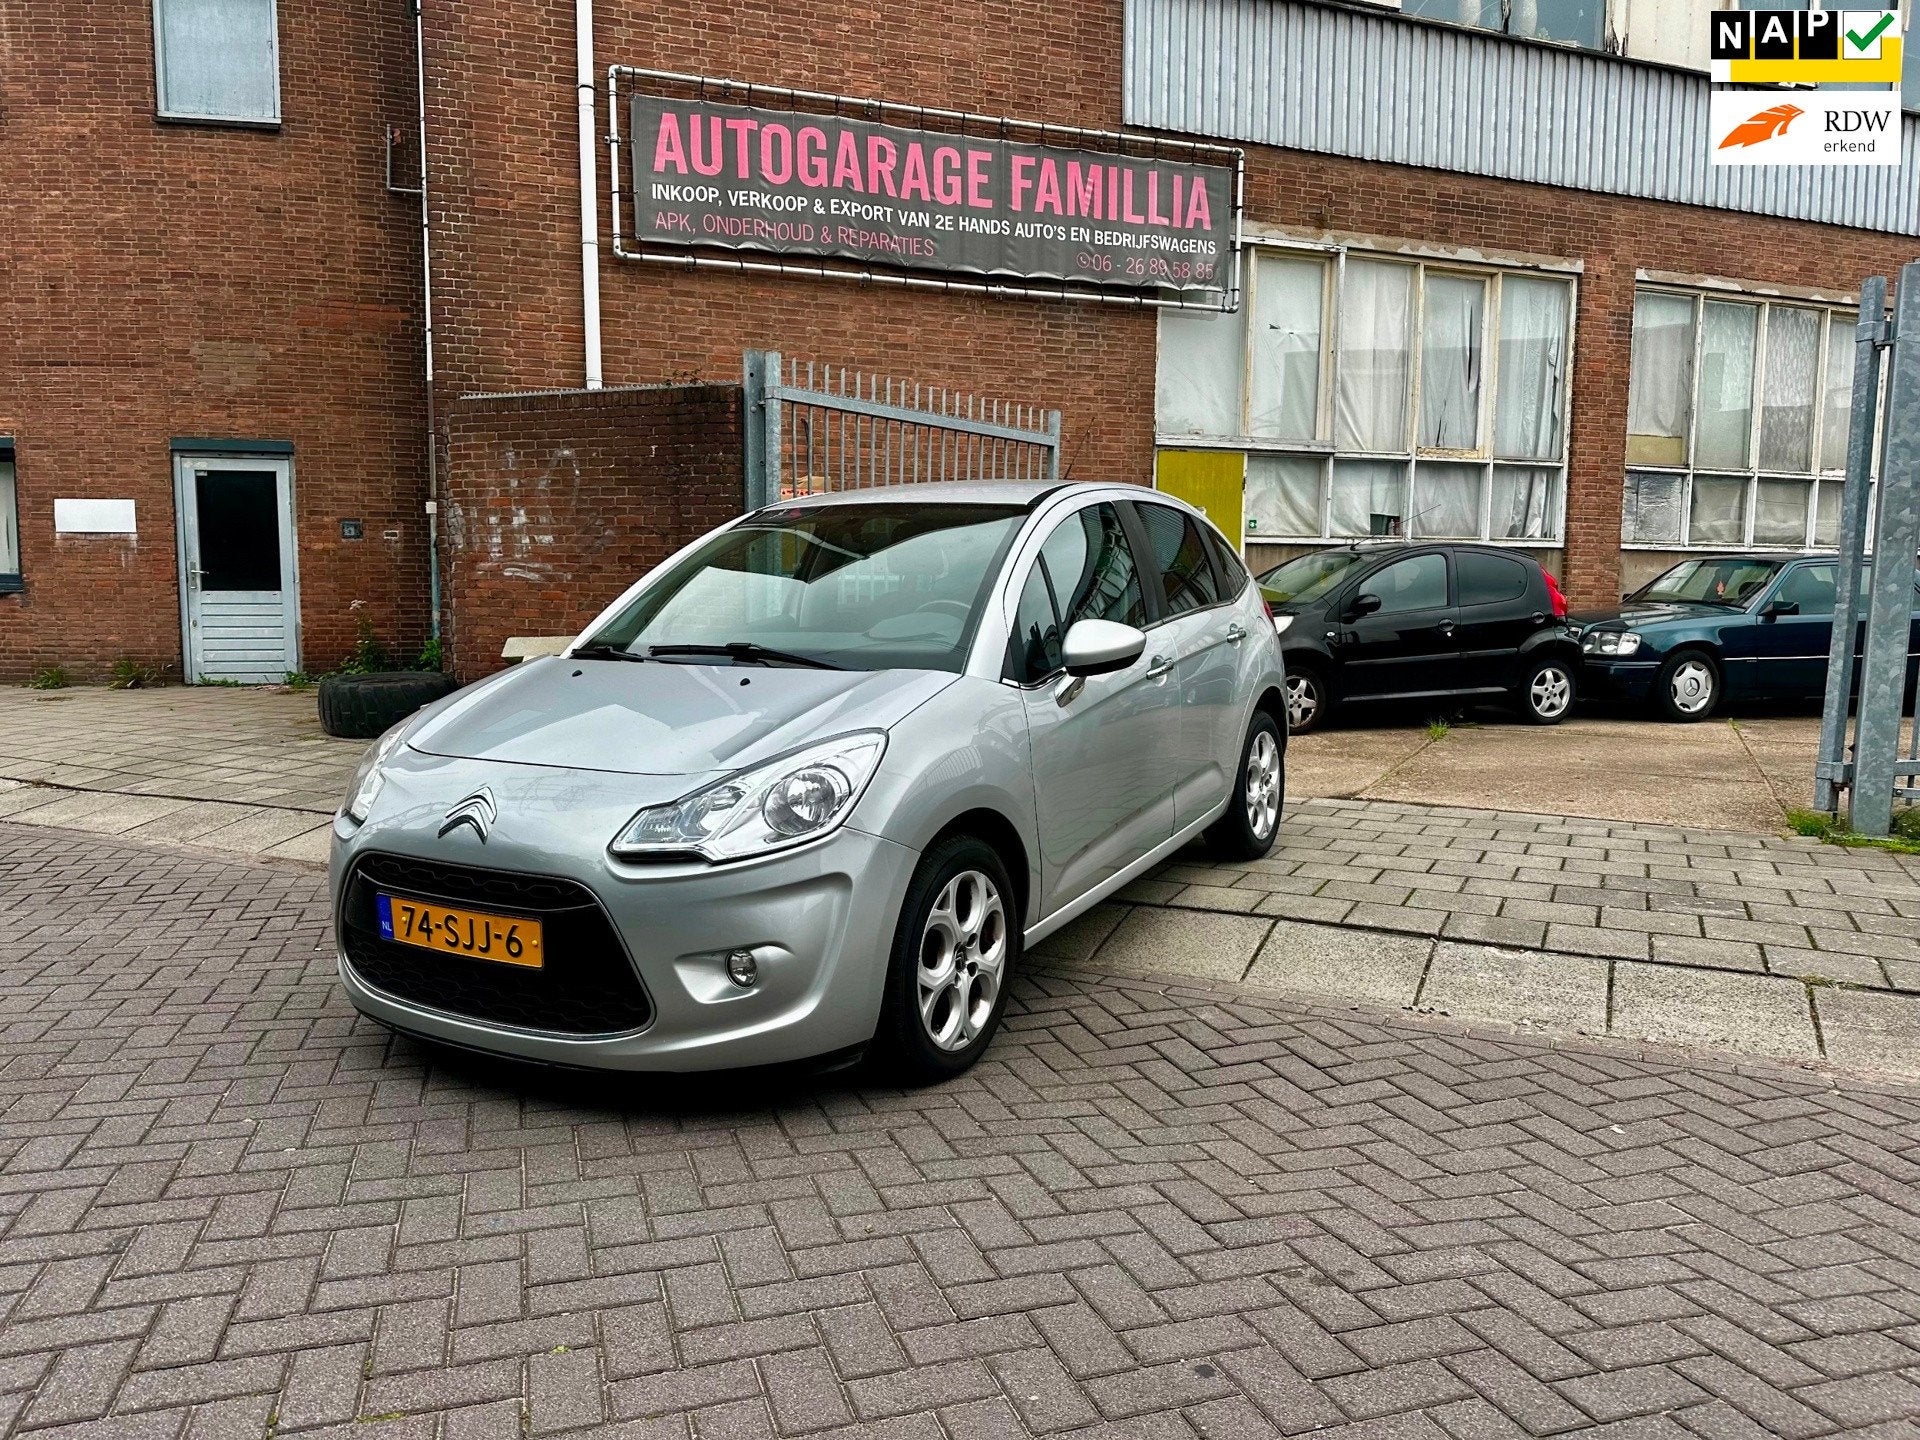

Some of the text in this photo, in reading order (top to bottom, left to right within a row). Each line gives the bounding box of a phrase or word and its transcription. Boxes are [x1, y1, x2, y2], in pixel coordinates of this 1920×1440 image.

[653, 112, 1212, 230] AUTOGARAGE FAMILLIA
[652, 183, 1217, 255] INKOOP, VERKOOP & EXPORT VAN 2E HANDS AUTO'S EN BEDRIJFSWAGENS
[655, 211, 935, 257] APK, ONDERHOUD & REPARATIES
[1092, 254, 1112, 272] 06
[1125, 257, 1145, 275] 26
[1149, 258, 1168, 276] 89
[1172, 261, 1191, 279] 58
[1195, 262, 1214, 280] 85
[381, 920, 392, 932] NL
[401, 905, 523, 958] 74-SJJ-6
